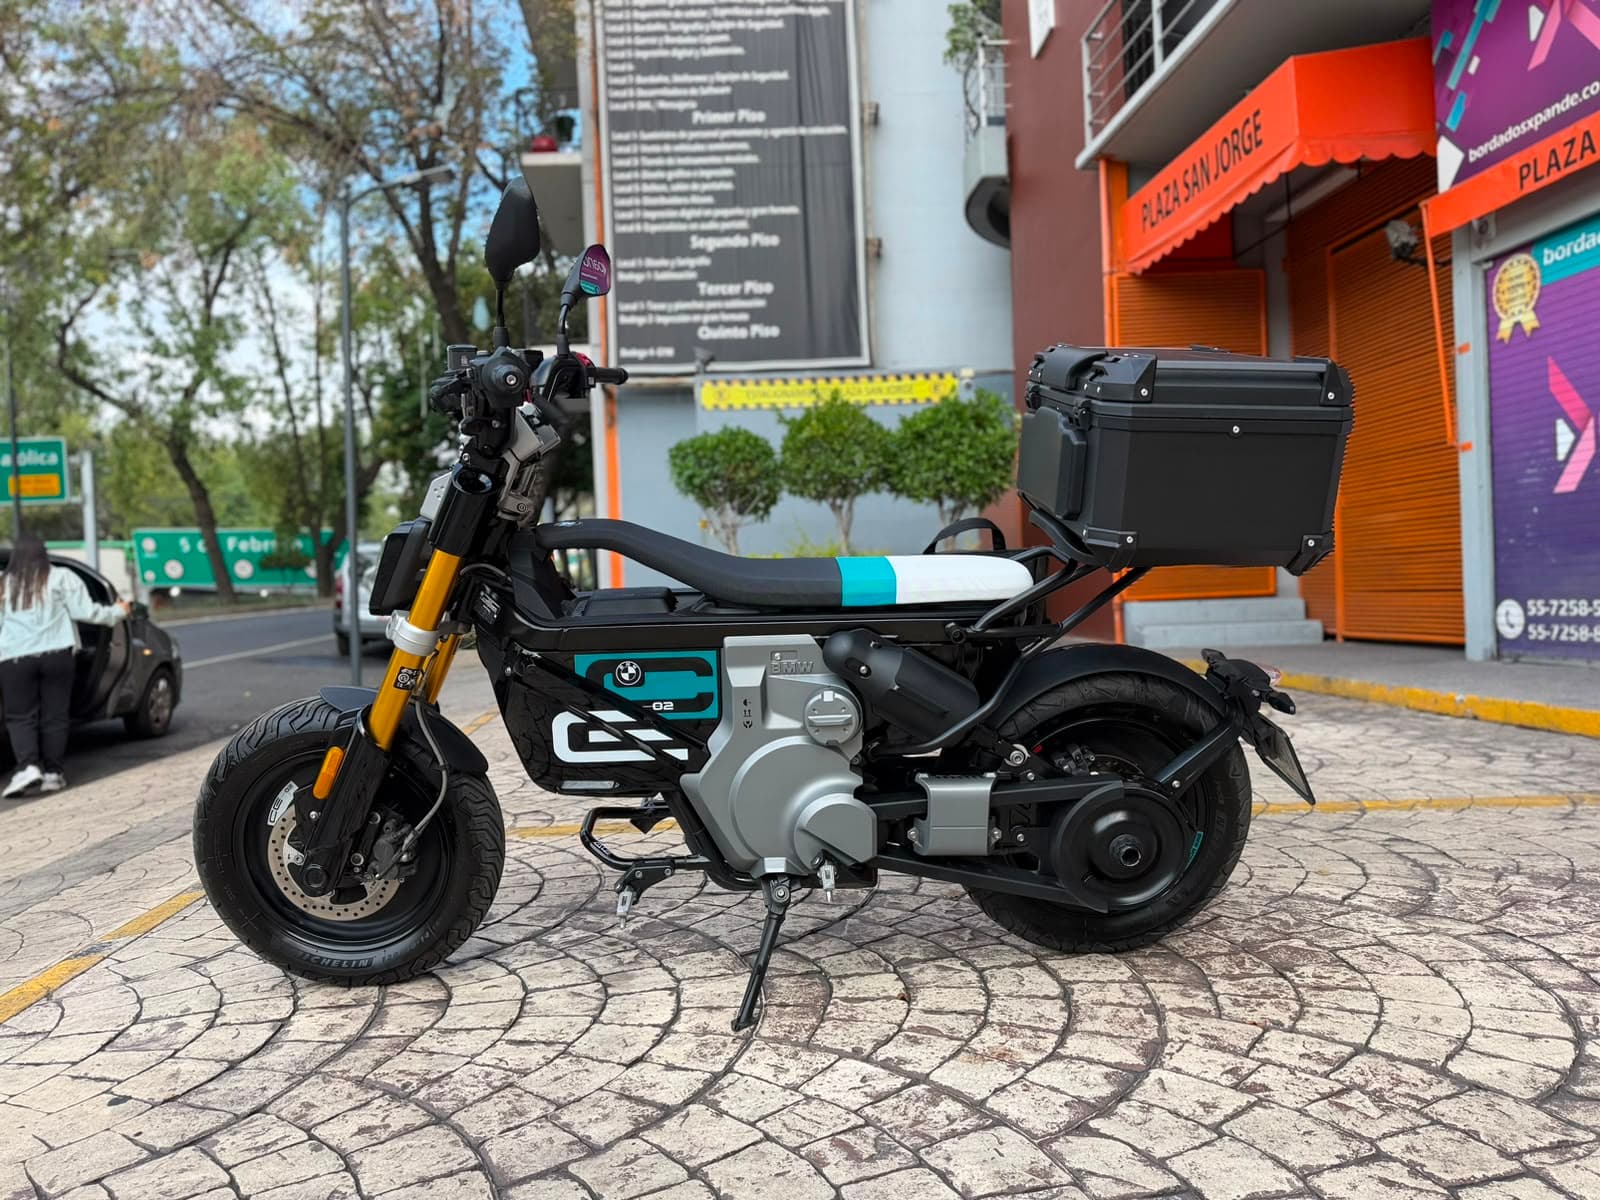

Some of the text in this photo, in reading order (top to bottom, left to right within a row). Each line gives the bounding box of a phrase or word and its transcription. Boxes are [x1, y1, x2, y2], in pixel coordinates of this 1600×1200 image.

[692, 108, 766, 124] Primer Piso
[1519, 129, 1597, 190] PLAZA
[1142, 108, 1263, 233] PLAZA SAN JORGE
[690, 232, 780, 252] Segundo Piso
[697, 280, 774, 295] Tercer Piso
[697, 324, 780, 339] Quinto Piso
[771, 661, 814, 673] BMW
